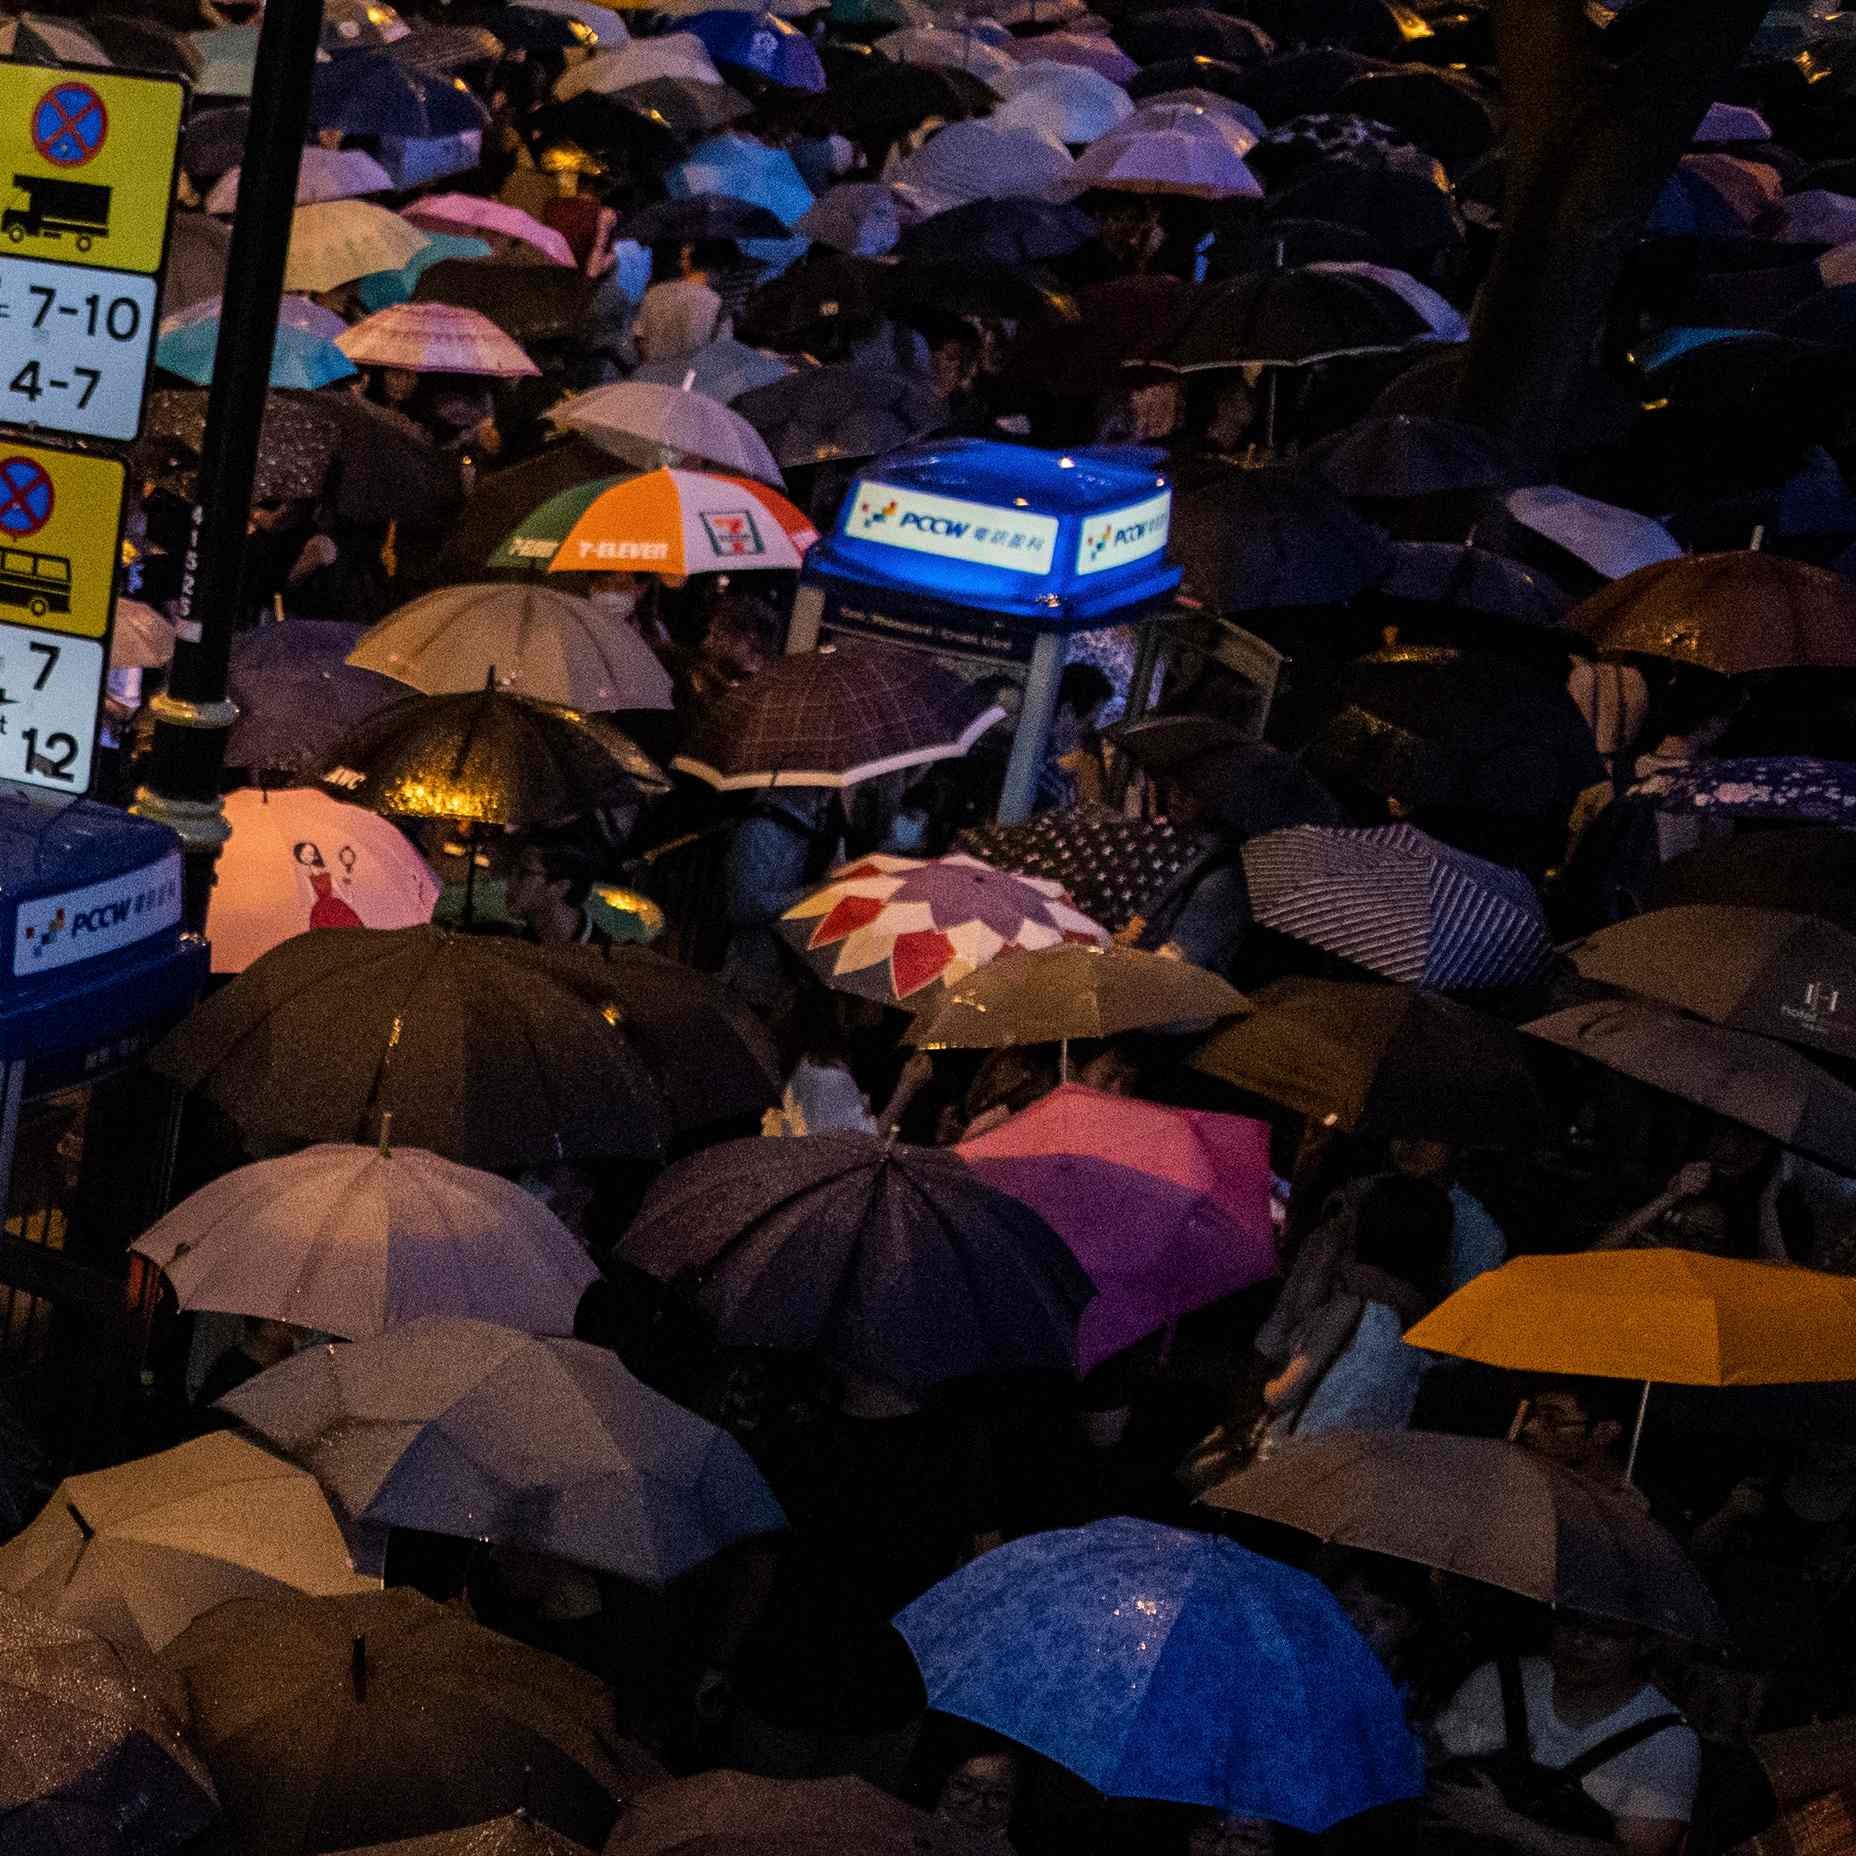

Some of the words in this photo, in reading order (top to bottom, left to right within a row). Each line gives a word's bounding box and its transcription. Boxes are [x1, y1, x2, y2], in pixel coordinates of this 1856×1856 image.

[29, 284, 141, 342] 7-10
[9, 360, 101, 409] 4-7
[900, 511, 970, 539] PCCW
[29, 640, 61, 691] 7
[21, 727, 79, 782] 12
[71, 894, 132, 938] PCCW
